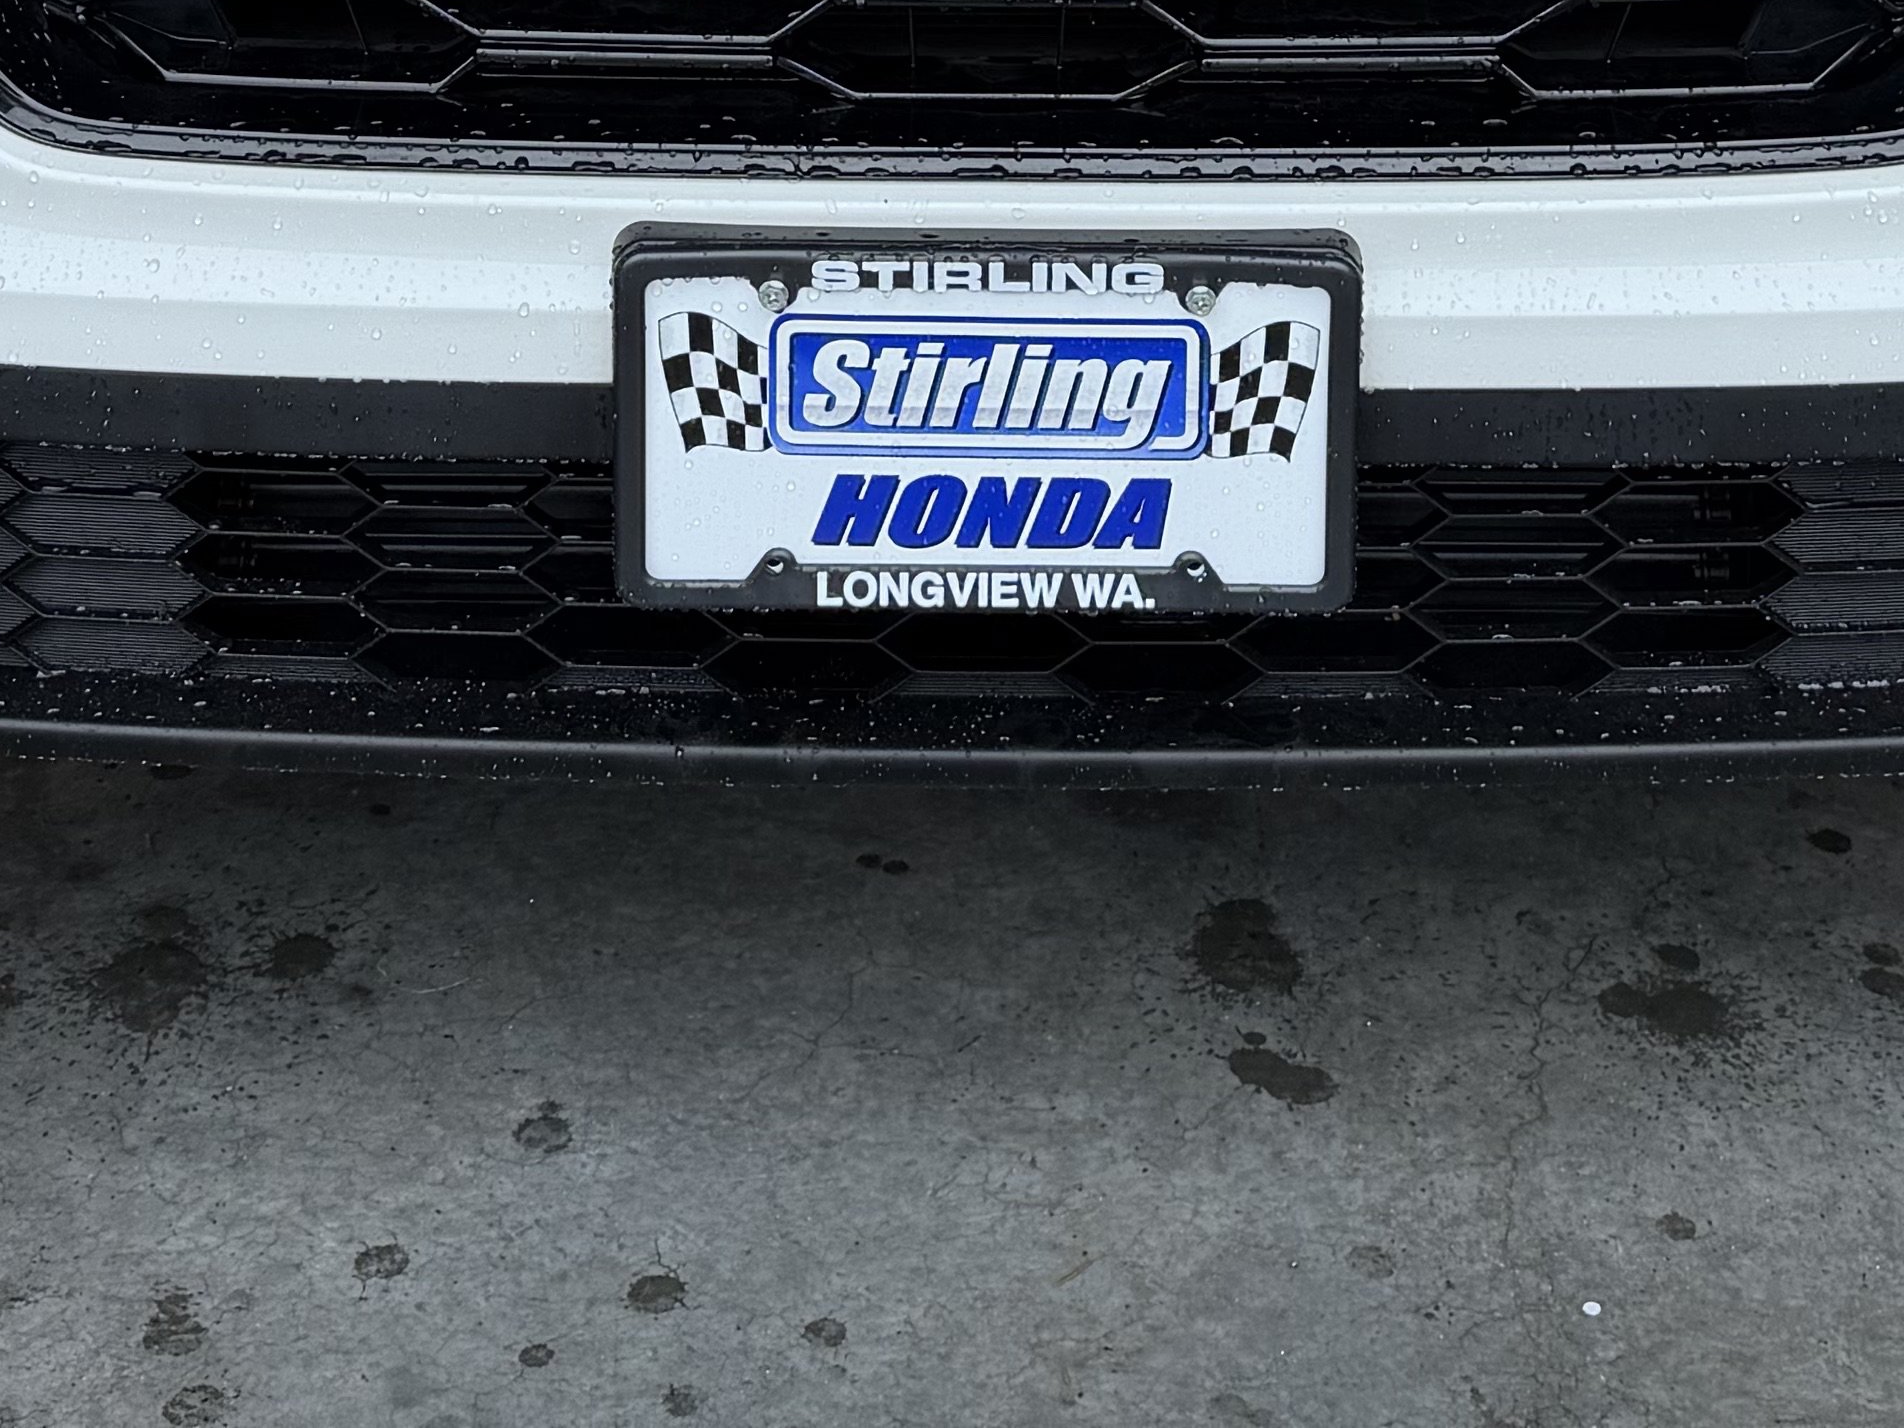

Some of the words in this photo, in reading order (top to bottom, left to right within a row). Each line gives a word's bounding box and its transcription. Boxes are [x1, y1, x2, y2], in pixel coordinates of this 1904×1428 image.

[810, 259, 1166, 295] STIRLING
[802, 339, 1172, 450] Stirling
[811, 473, 1172, 550] HONDA
[815, 570, 1064, 609] LONGVIEW
[1070, 572, 1157, 610] WA.
